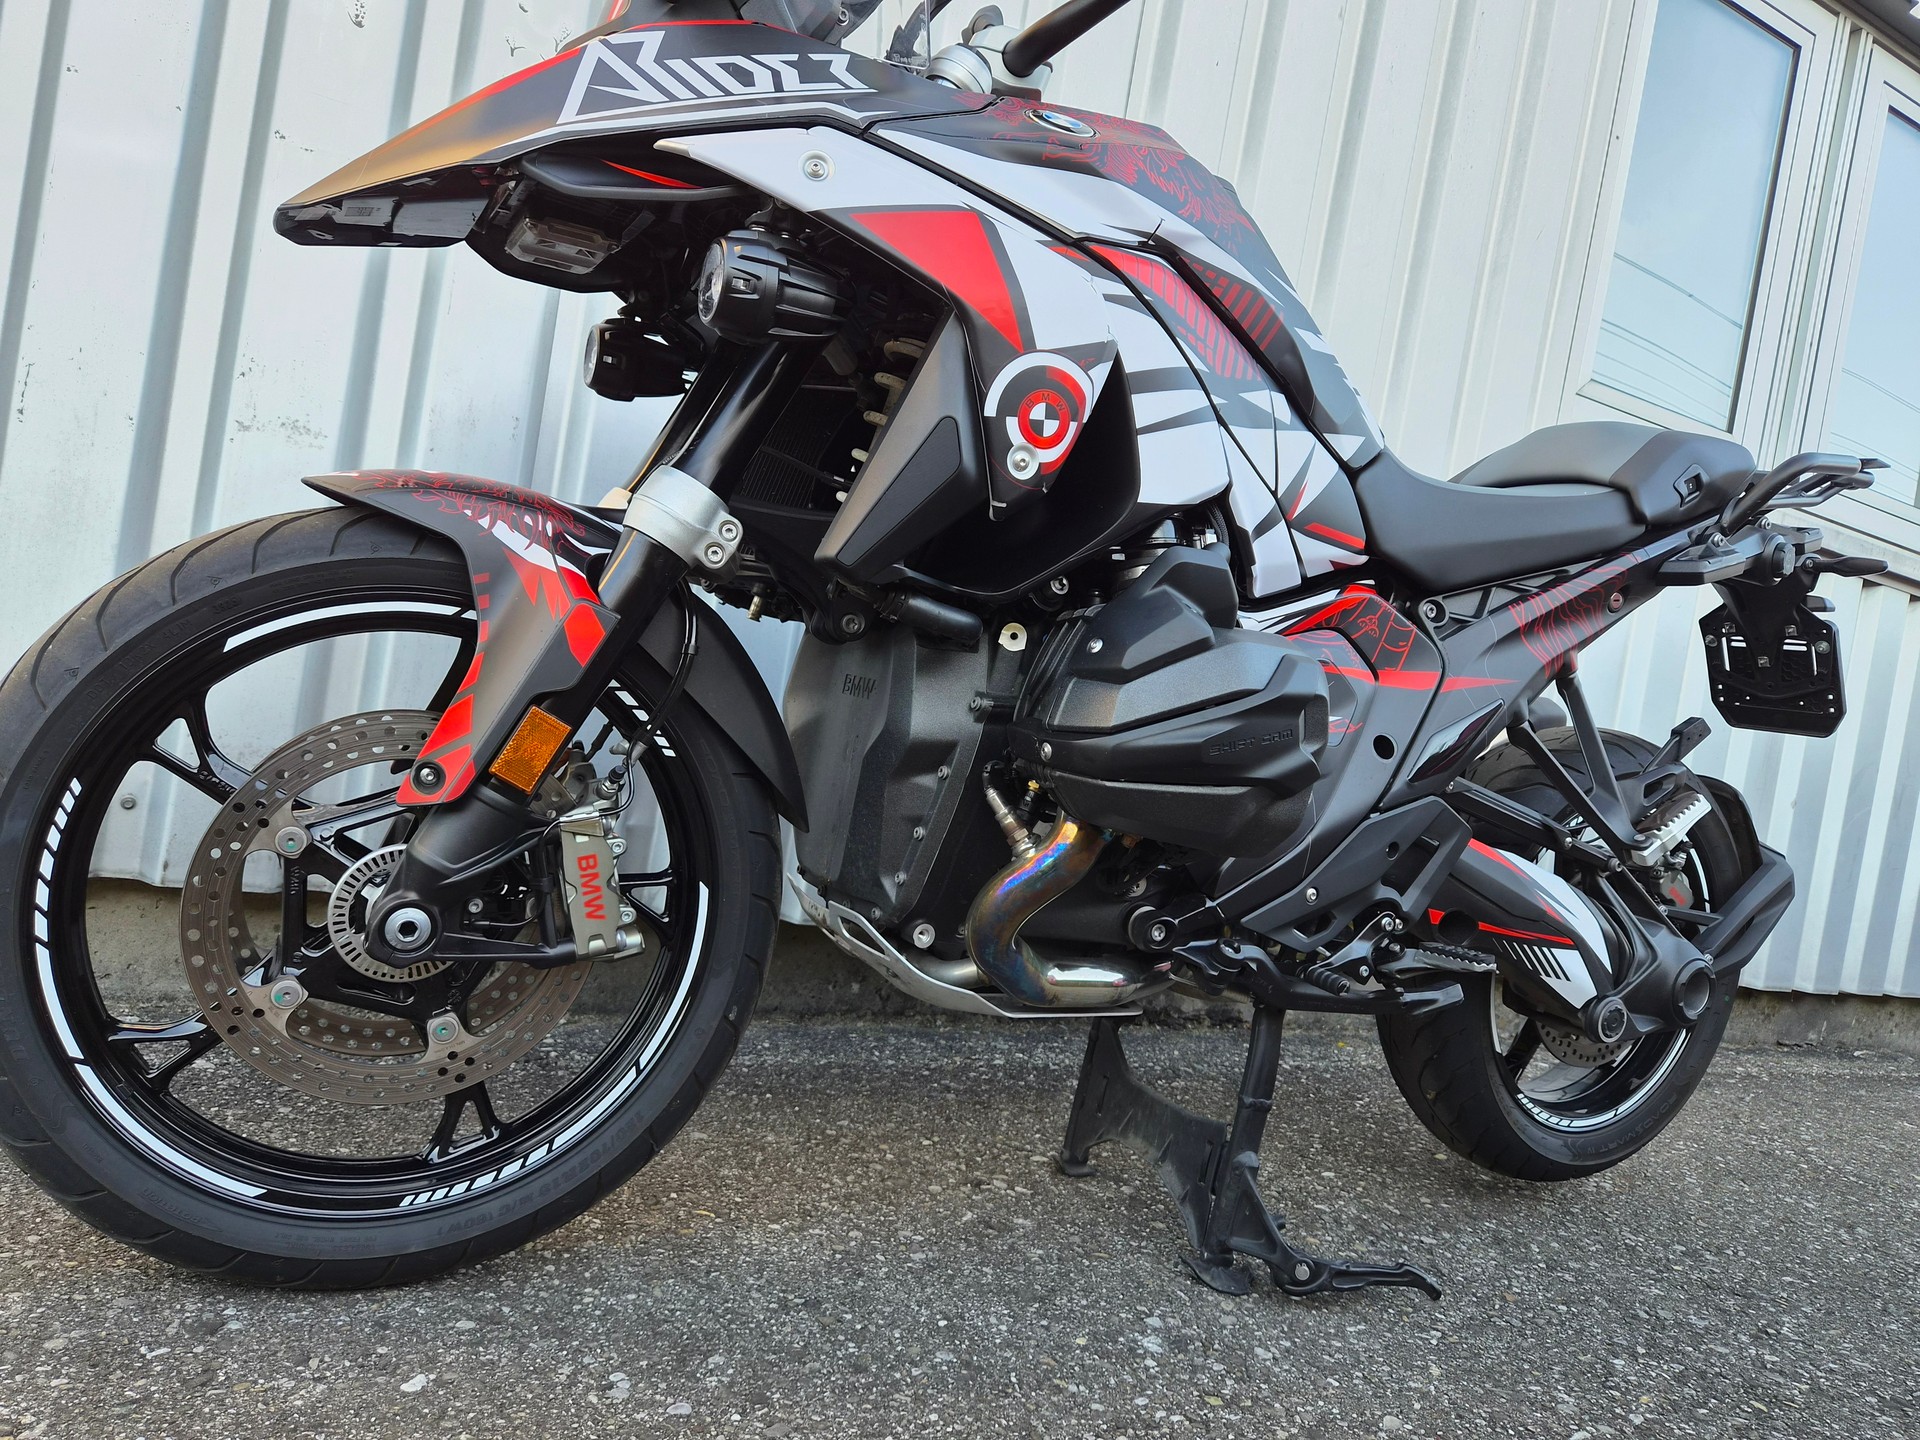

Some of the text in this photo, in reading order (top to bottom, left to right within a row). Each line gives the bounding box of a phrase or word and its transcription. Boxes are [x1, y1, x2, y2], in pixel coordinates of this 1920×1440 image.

[1025, 393, 1065, 411] BMW
[842, 673, 876, 700] BMW
[1209, 736, 1255, 757] SHIFT
[577, 853, 606, 920] BMW
